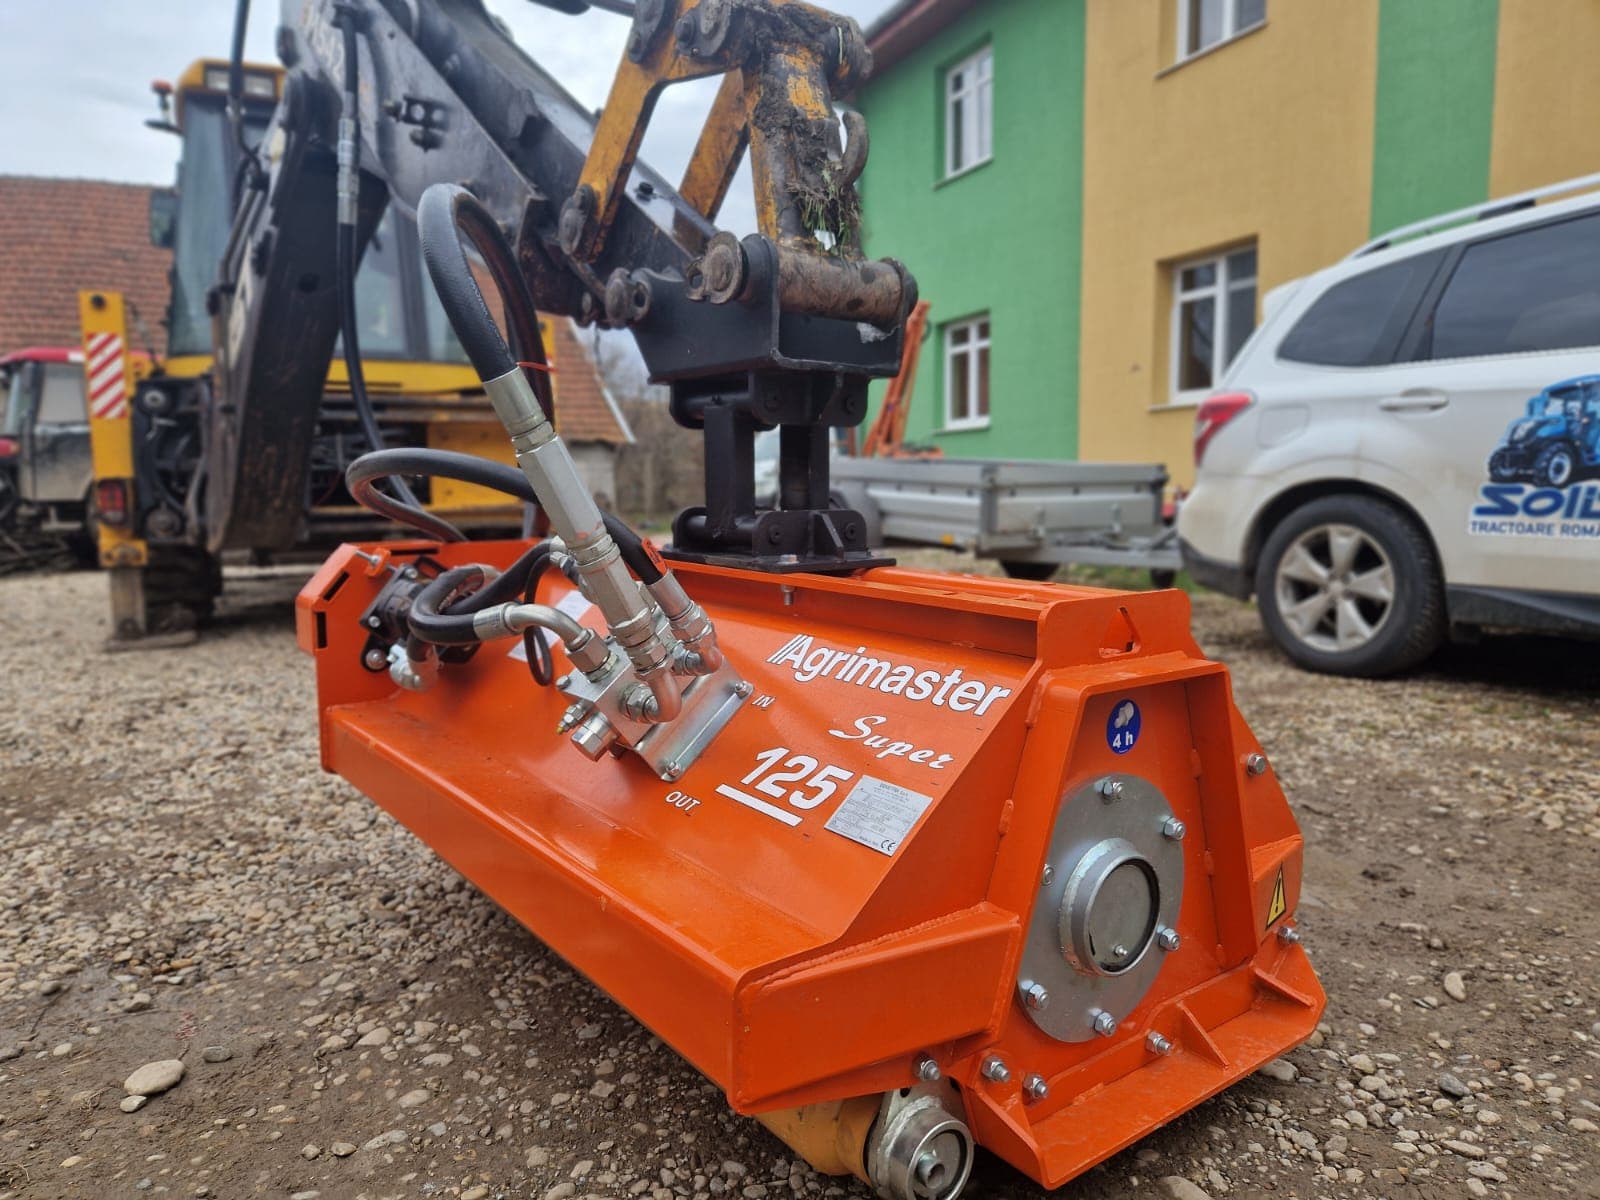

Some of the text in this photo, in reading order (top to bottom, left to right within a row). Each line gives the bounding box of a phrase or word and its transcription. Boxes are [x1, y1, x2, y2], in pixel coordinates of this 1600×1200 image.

[1471, 520, 1554, 537] TRACTOARE
[766, 634, 1012, 716] Agrimaster
[752, 694, 775, 708] IN
[828, 715, 954, 769] Super
[1112, 731, 1133, 748] 4 h
[741, 747, 854, 810] 125
[665, 791, 701, 811] OUT
